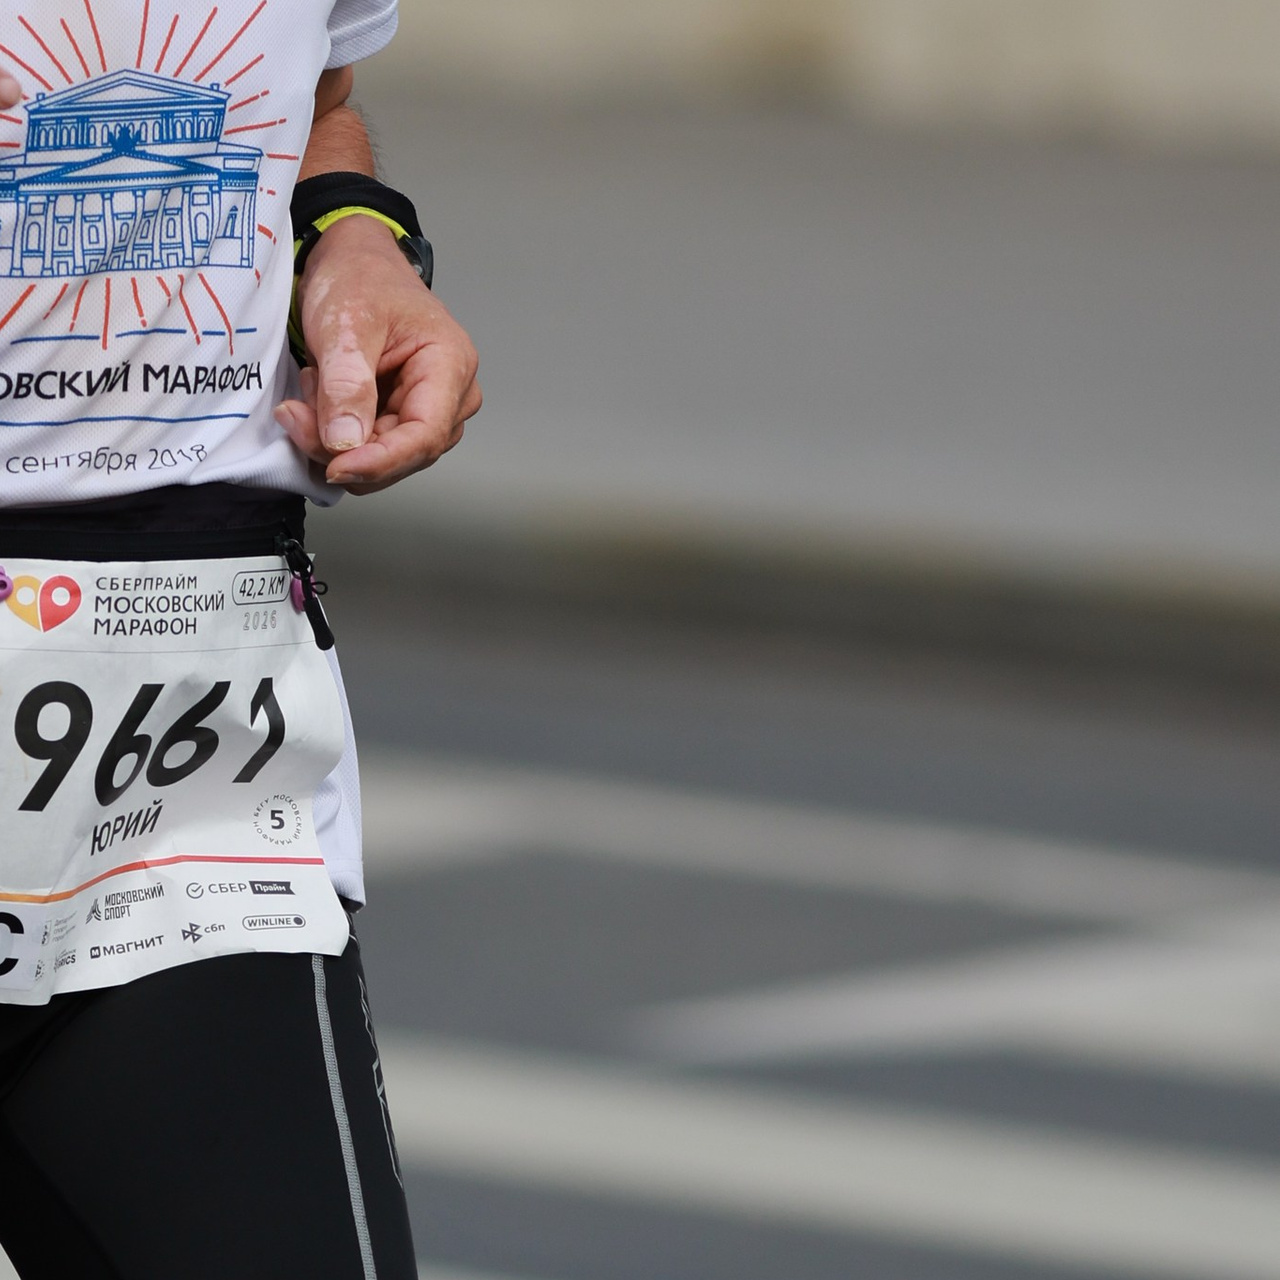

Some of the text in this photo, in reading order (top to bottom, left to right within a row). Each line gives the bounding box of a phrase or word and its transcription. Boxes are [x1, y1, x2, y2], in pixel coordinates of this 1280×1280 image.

[143, 362, 263, 397] МАРАФОН
[5, 450, 138, 475] сентября
[147, 444, 208, 471] 2018
[96, 574, 198, 592] СБЕРПРАЙМ
[239, 575, 286, 599] 42,2 КМ
[95, 590, 225, 614] МОСКОВСКИЙ
[94, 618, 198, 636] МАРАФОН
[243, 610, 278, 631] 2026
[14, 677, 285, 812] 9661
[91, 799, 163, 856] ЮРИЙ
[270, 809, 285, 829] 5
[105, 882, 165, 907] МОСКОВСКИЙ
[208, 883, 287, 895] СБЕР Прайм
[104, 905, 131, 920] СПОРТ
[247, 917, 291, 927] WINLINE
